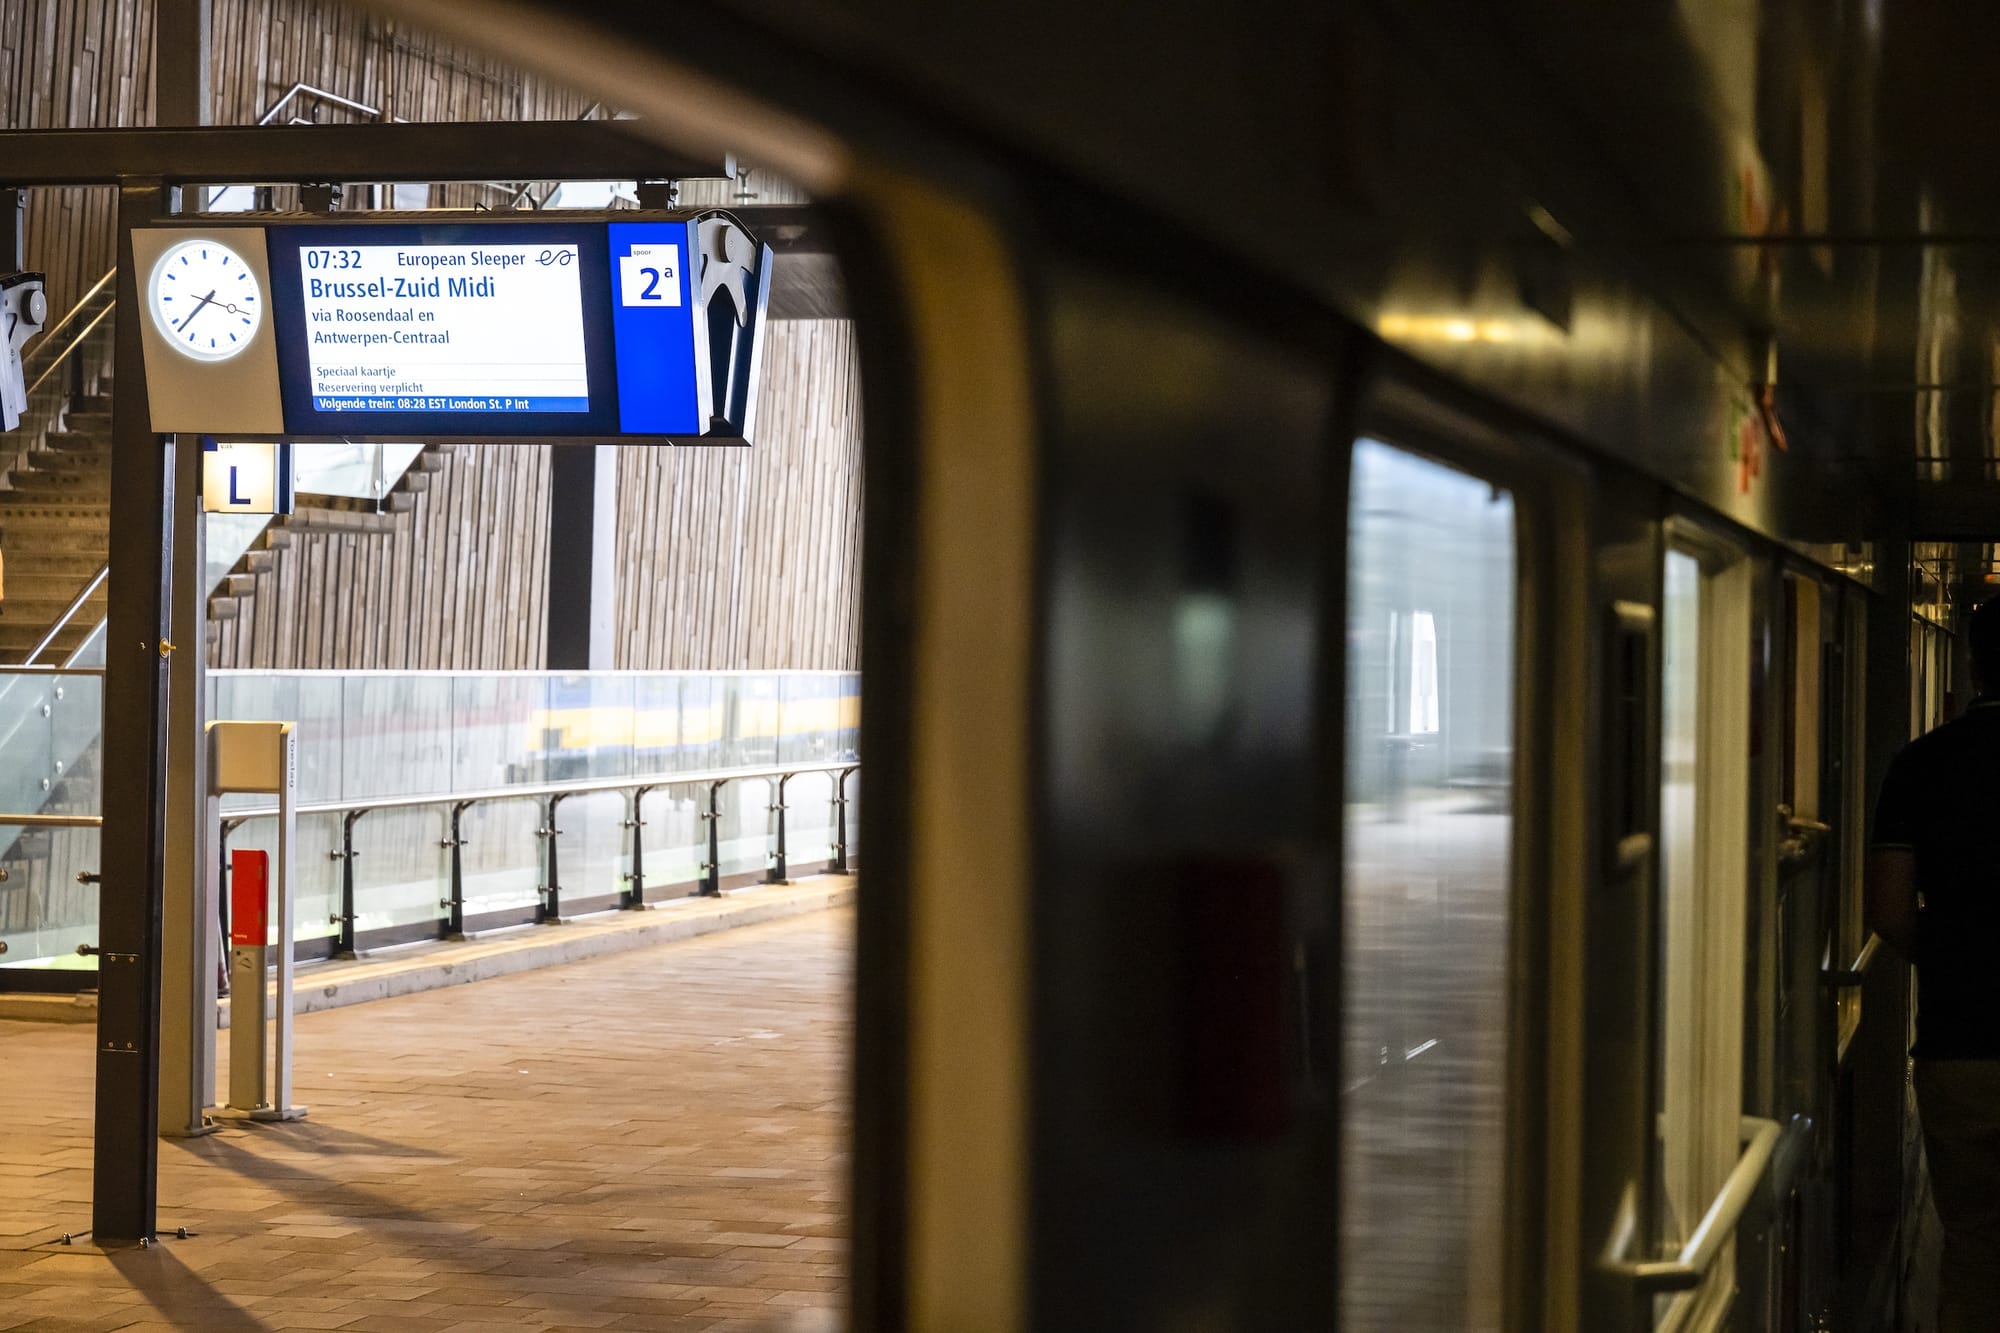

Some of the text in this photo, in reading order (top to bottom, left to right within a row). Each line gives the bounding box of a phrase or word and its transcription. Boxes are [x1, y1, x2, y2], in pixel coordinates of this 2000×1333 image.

[307, 250, 362, 269] 07:32
[397, 251, 526, 270] European Sleeper
[310, 276, 495, 298] Brussel-Zuid Midi
[312, 308, 435, 322] via Roosendaal en
[314, 330, 449, 346] Antwerpen-Centraal
[317, 366, 396, 379] Speciaal kaartje
[318, 382, 424, 394] Reservering verplicht
[319, 397, 529, 411] Volgende trein: 08:28 EST London St. P Int
[229, 466, 251, 504] L
